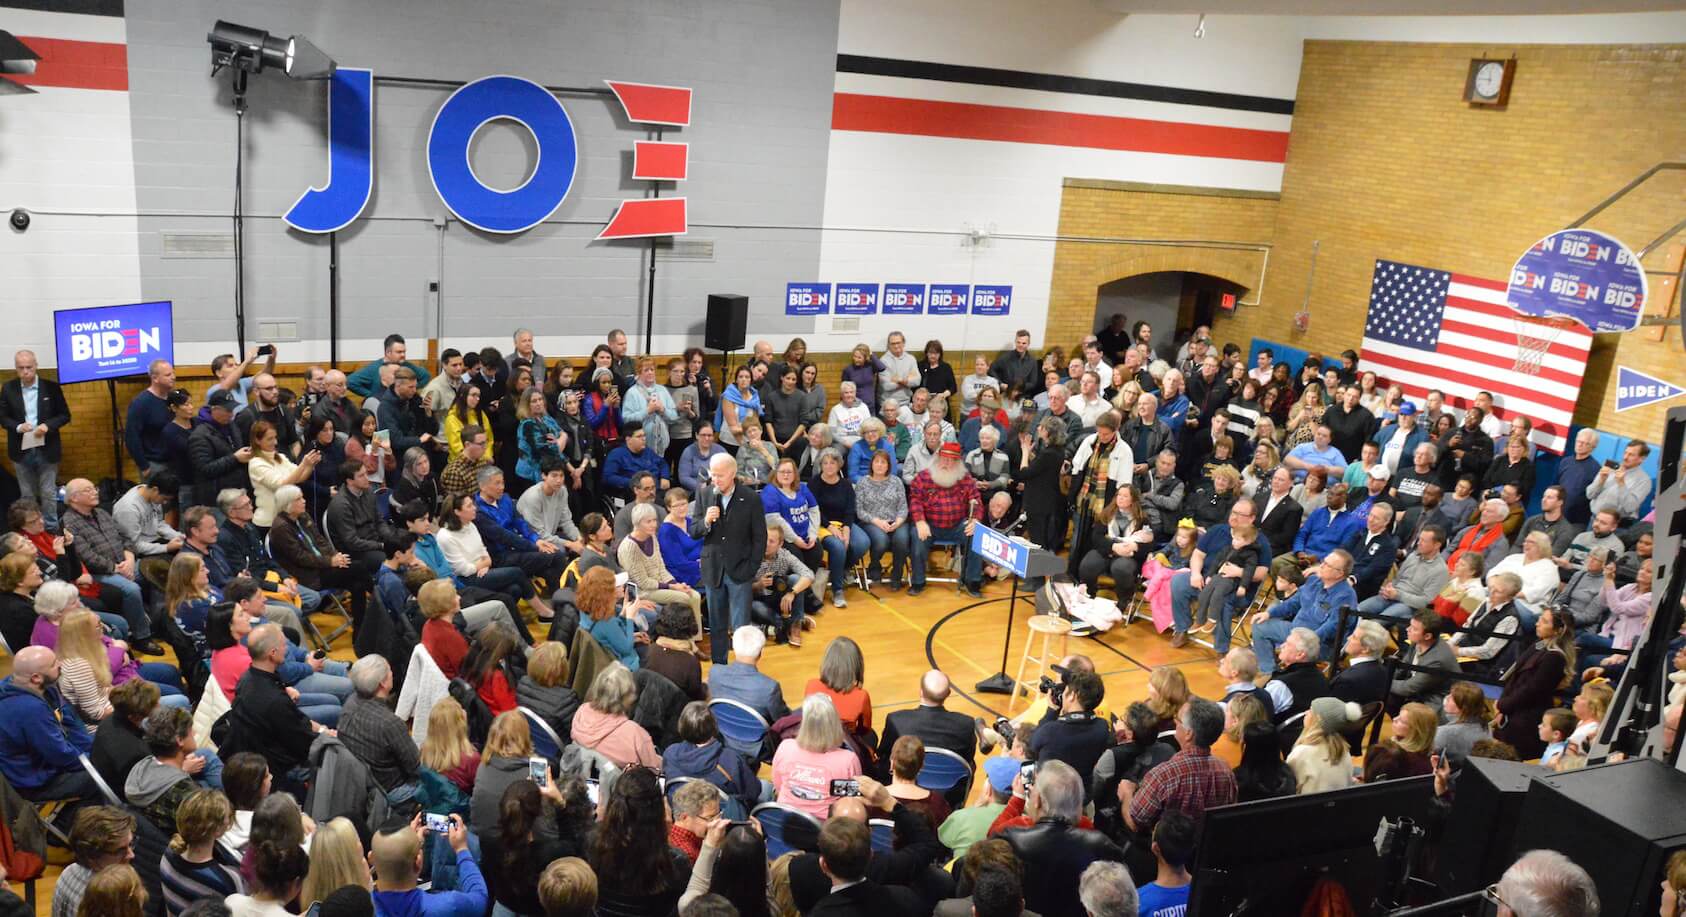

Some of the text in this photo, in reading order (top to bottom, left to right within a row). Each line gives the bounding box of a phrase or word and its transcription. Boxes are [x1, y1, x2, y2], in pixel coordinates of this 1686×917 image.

[281, 68, 693, 240] JOE
[1560, 239, 1611, 262] BIDEN
[1550, 277, 1600, 300] BIDEN
[788, 293, 828, 306] BIDEN
[837, 293, 875, 305] BIDEN
[886, 294, 922, 305] BIDEN
[930, 294, 967, 306] BIDEN
[975, 295, 1009, 306] BIDEN
[70, 320, 121, 333] IOWA FOR
[71, 327, 160, 361] BIDEN
[1619, 385, 1669, 399] BIDEN
[981, 532, 1018, 565] BIDEN
